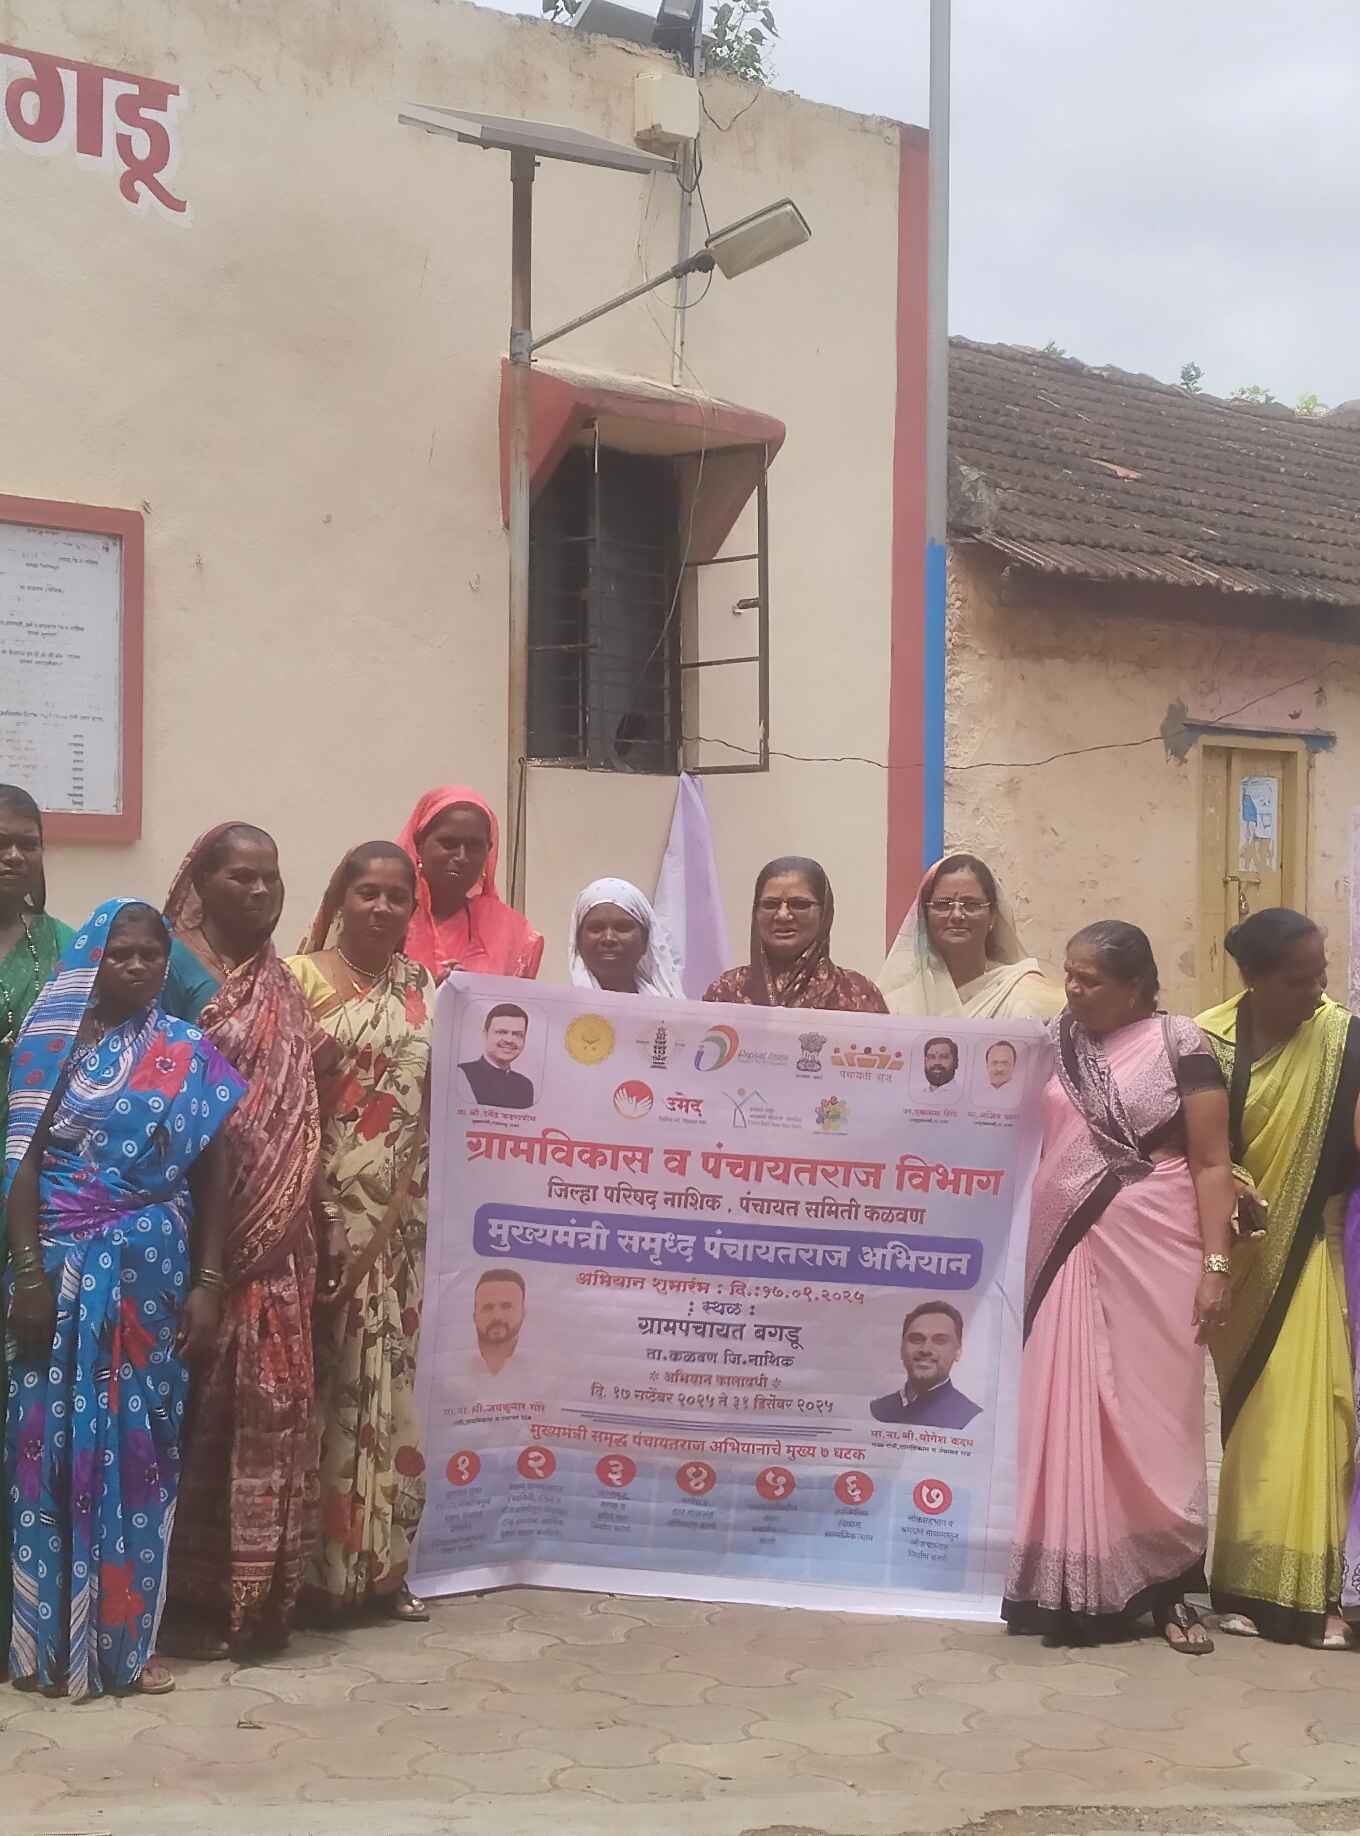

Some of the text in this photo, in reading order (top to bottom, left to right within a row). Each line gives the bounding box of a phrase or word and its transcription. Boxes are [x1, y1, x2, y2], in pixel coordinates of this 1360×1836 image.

[464, 1127, 1005, 1196] ग्रामविकास व पंचायतराज विभाग
[548, 1176, 598, 1202] जिल्हा
[604, 1180, 658, 1210] परिषद
[806, 1196, 861, 1221] समिती
[863, 1204, 926, 1225] कळवण
[488, 1216, 611, 1252] मुख्यमंत्री
[703, 1228, 851, 1268] पंचायतराज
[857, 1240, 971, 1276] अभियान
[576, 1269, 646, 1290] अभियान
[652, 1274, 710, 1296] शुभारंभ
[702, 1300, 741, 1316] स्थळ
[754, 1323, 804, 1350] बगडू
[457, 1454, 470, 1481] १
[527, 1450, 546, 1478] २
[607, 1459, 624, 1486] ३
[686, 1465, 706, 1491] ४
[765, 1470, 788, 1497] ५
[845, 1475, 861, 1502] ६
[921, 1485, 944, 1510] ७
